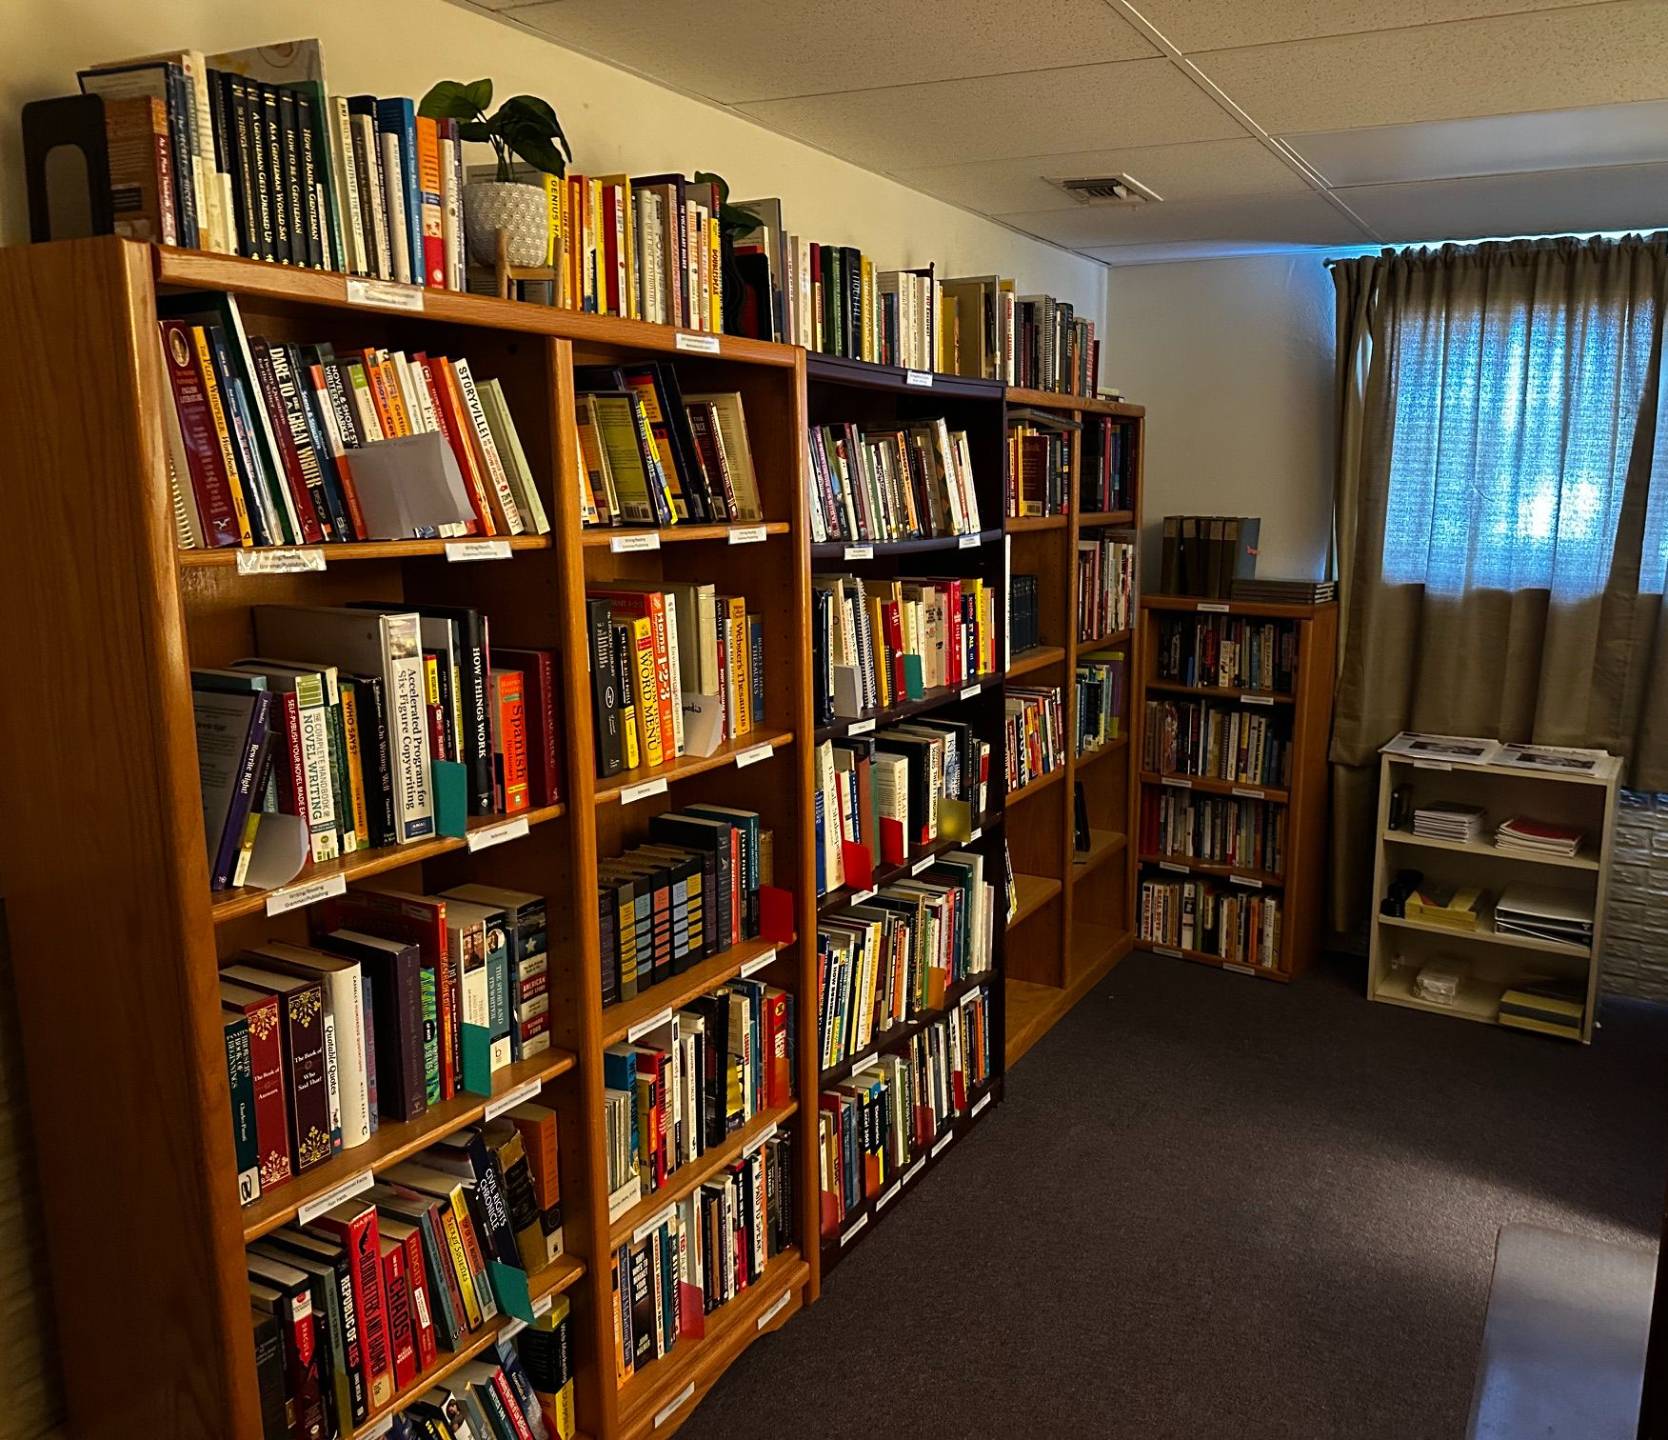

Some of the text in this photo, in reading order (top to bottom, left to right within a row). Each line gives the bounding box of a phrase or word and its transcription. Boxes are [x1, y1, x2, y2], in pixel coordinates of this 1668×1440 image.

[286, 130, 295, 150] HOW
[290, 152, 296, 163] TO
[303, 129, 312, 149] HOW
[305, 152, 312, 161] TO
[253, 112, 272, 243] A GENTLEMAN GETS DRESSED UP
[271, 143, 282, 191] GENTLEMAN
[306, 163, 314, 185] RAISE
[346, 155, 356, 193] MOTIVATE
[276, 193, 285, 225] WOULD
[292, 185, 302, 234] GENTLEMAN
[309, 193, 319, 241] GENTLEMAN
[279, 226, 287, 241] SAY
[203, 359, 216, 382] PLOT
[261, 370, 269, 382] the
[269, 347, 290, 379] DARE
[209, 385, 226, 433] WHISPERER
[264, 384, 275, 408] Writer
[280, 382, 295, 397] TO
[325, 366, 349, 442] WRITER'S MARKET
[331, 365, 345, 395] NOVEL
[341, 404, 356, 433] SHORT
[458, 366, 489, 438] STORYVILLE!
[288, 413, 309, 445] GREAT
[221, 436, 235, 477] Workbook
[297, 447, 322, 489] WRITER
[657, 612, 670, 701] Home 1-2-3
[736, 623, 747, 727] Webster's Thesaurus
[288, 699, 300, 743] SELF-PUBLISH
[472, 648, 487, 758] HOW THINGS WORK
[641, 653, 658, 751] WORD MENU
[315, 723, 325, 764] COMPLETE
[346, 701, 357, 755] WHO SAYS?
[397, 670, 416, 810] Six-Figure Copywriting
[407, 668, 426, 807] Accelerated Program for
[511, 705, 526, 780] Spanish
[241, 744, 260, 794] Rewrite Right!
[292, 744, 300, 762] YOUR
[294, 763, 303, 786] NOVEL
[304, 715, 322, 820] NOVEL WRITING
[378, 725, 390, 792] On Writing Well
[506, 740, 515, 784] Dictionary
[297, 786, 305, 803] MADE
[318, 766, 329, 808] HANDBOOK
[496, 1002, 504, 1024] AND
[228, 1041, 238, 1089] BEGINNINGS
[254, 1074, 264, 1082] The
[264, 1070, 274, 1080] Book
[294, 1055, 304, 1064] The
[304, 1051, 316, 1060] Book
[325, 1026, 337, 1096] Quotable Quotes
[479, 1178, 500, 1231] CHRONICLE
[485, 1168, 507, 1227] CIVIL RIGHTS
[756, 1209, 762, 1219] TO
[409, 1237, 422, 1285] PLEDGED
[447, 1216, 469, 1282] SECRET SOCIETIES
[340, 1275, 359, 1368] REPUBLIC OF LIES
[367, 1316, 379, 1338] AND
[389, 1278, 409, 1342] CHAOS
[622, 1303, 631, 1340] Marketing
